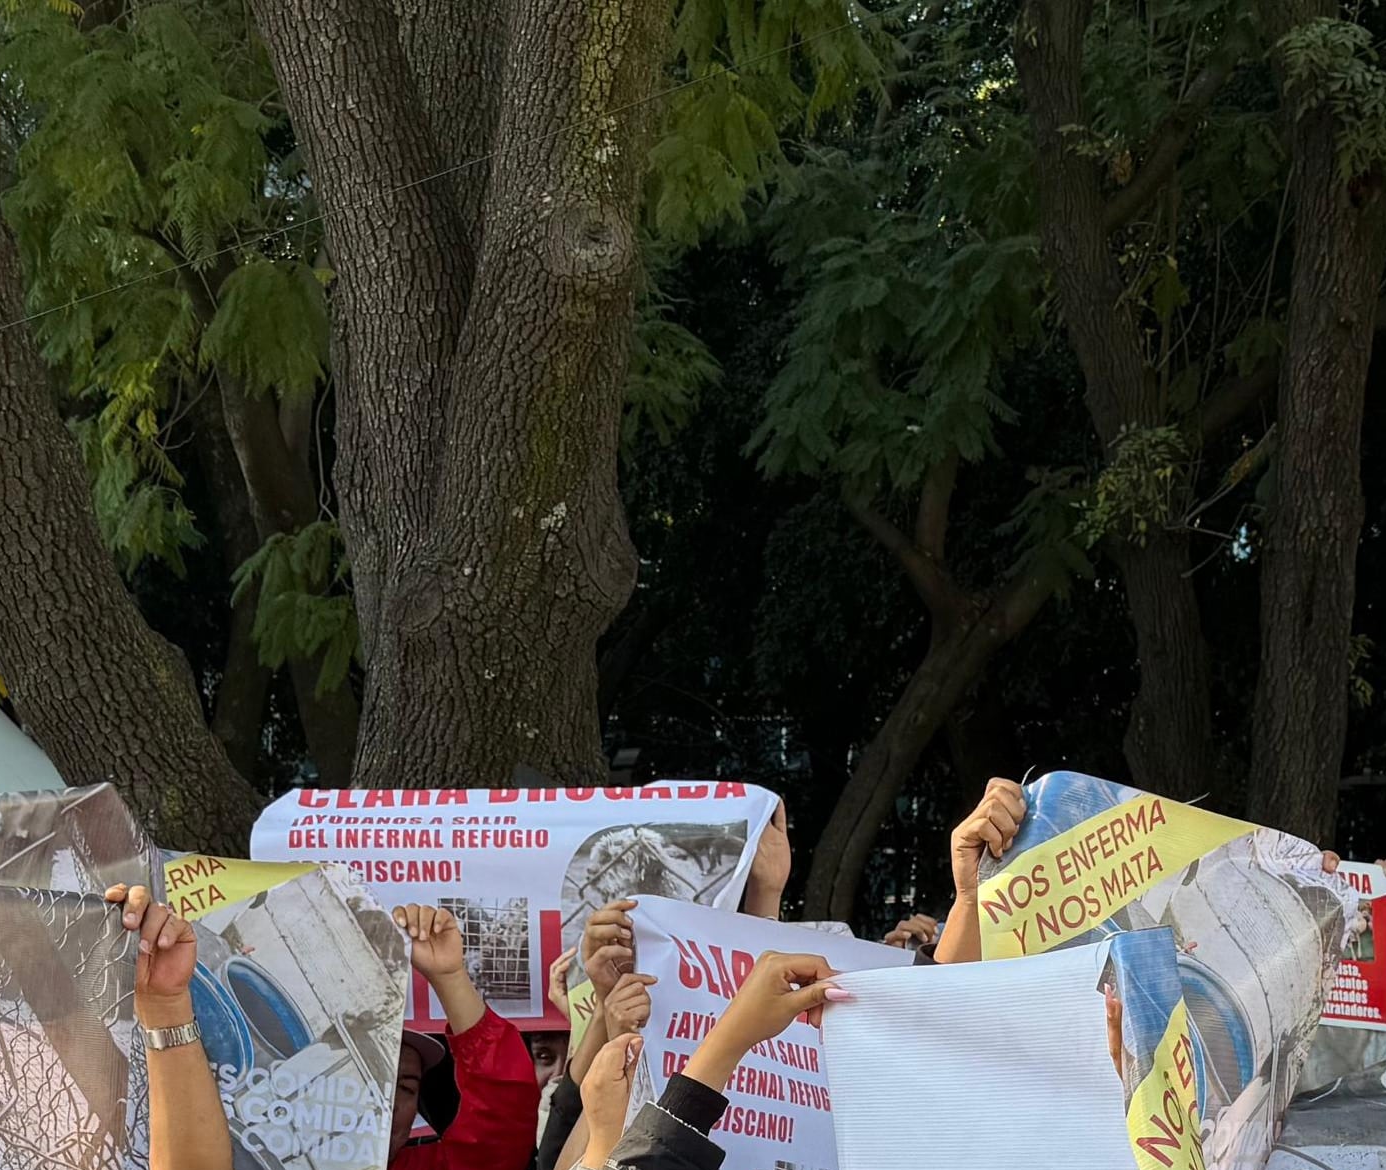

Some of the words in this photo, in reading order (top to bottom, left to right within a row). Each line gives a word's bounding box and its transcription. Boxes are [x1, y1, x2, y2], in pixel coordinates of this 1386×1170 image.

[288, 829, 328, 849] DEL
[336, 829, 444, 849] INFERNAL
[452, 828, 549, 849] REFUGIO
[429, 816, 443, 825] A
[452, 815, 517, 826] SALIR
[980, 864, 1050, 925] NOS
[1055, 799, 1166, 886] ENFERMA
[1012, 919, 1028, 955] Y
[1035, 885, 1102, 943] NOS
[1100, 845, 1164, 906] MATA
[777, 1039, 820, 1074] SALIR
[727, 1065, 785, 1102] FERNAL
[787, 1078, 831, 1112] REFUG
